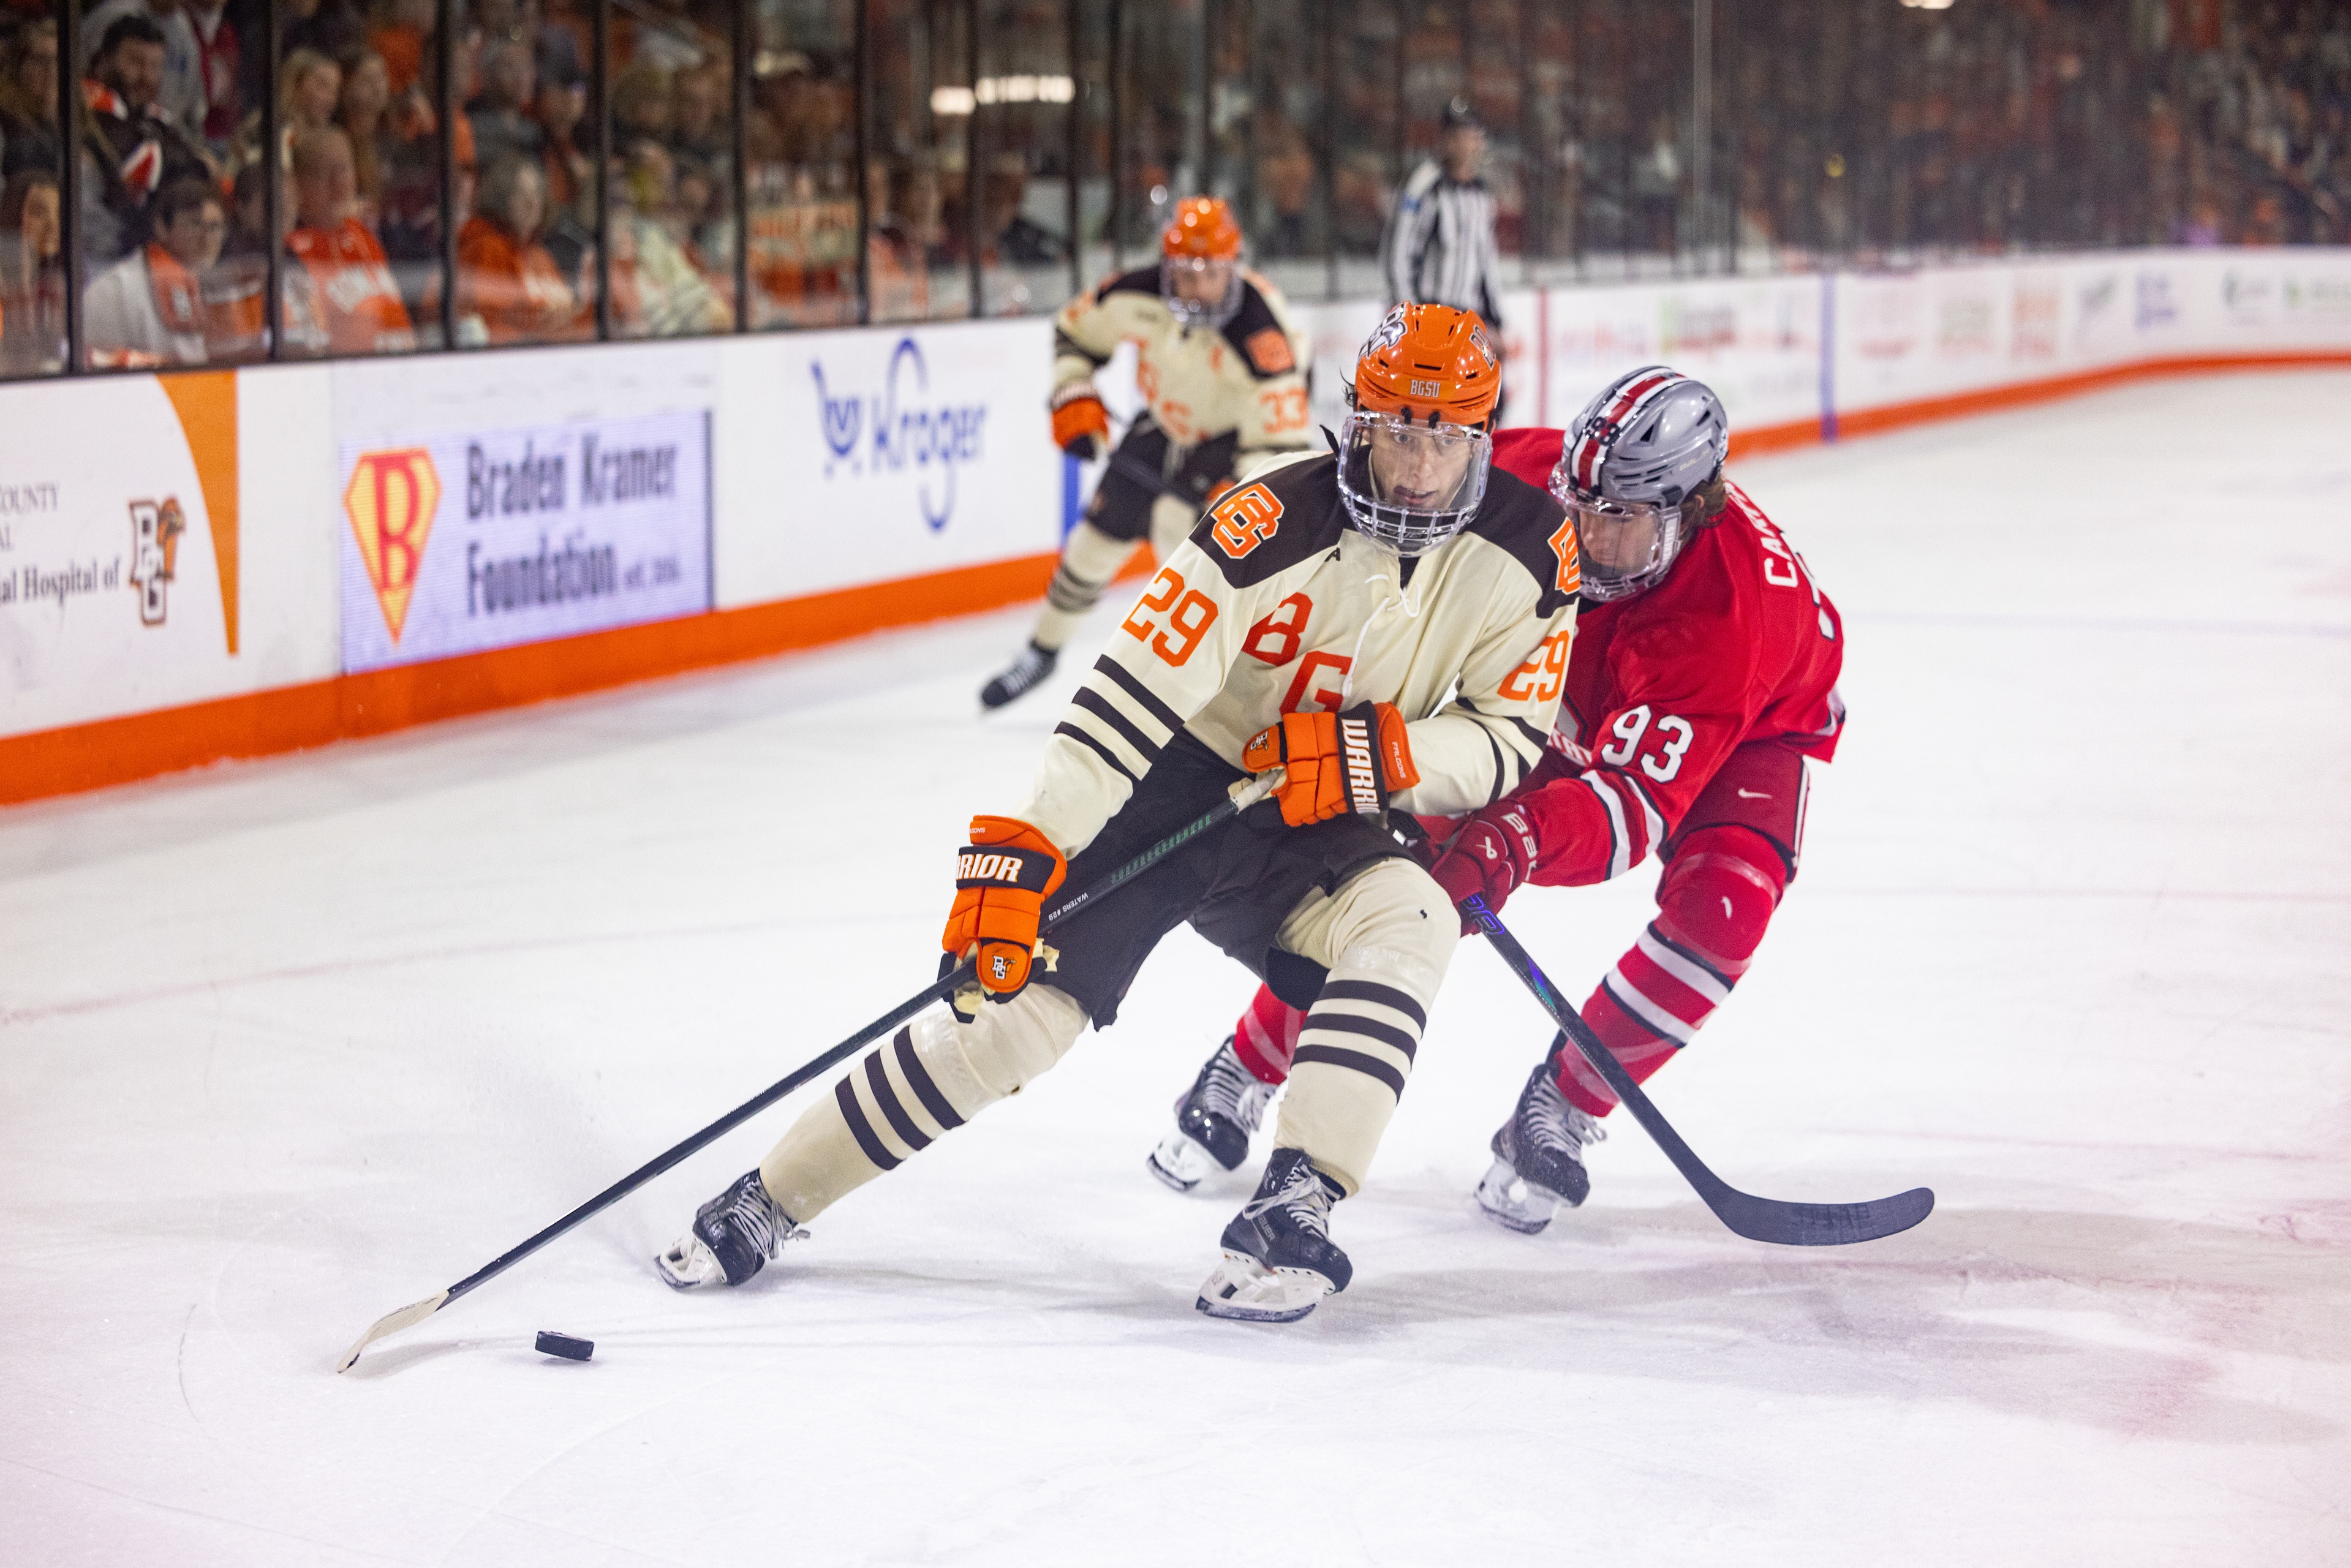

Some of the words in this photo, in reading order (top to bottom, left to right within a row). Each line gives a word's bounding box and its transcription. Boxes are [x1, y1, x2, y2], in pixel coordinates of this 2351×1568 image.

[1259, 387, 1310, 434] 33
[1409, 379, 1441, 398] BGSU
[872, 336, 987, 534] Kroger
[0, 480, 60, 516] OUNTY
[468, 435, 564, 520] Braden
[581, 433, 677, 505] Kramer
[374, 454, 420, 592] B
[23, 556, 98, 609] Hospital
[102, 554, 121, 592] of
[468, 526, 618, 618] Foundation
[1121, 567, 1218, 667] 29
[1497, 630, 1569, 702] 29
[1392, 741, 1406, 779] FALCONS
[1601, 704, 1695, 784] 93
[1048, 909, 1062, 922] #29
[1062, 892, 1089, 914] WATERS
[992, 955, 1006, 979] BG
